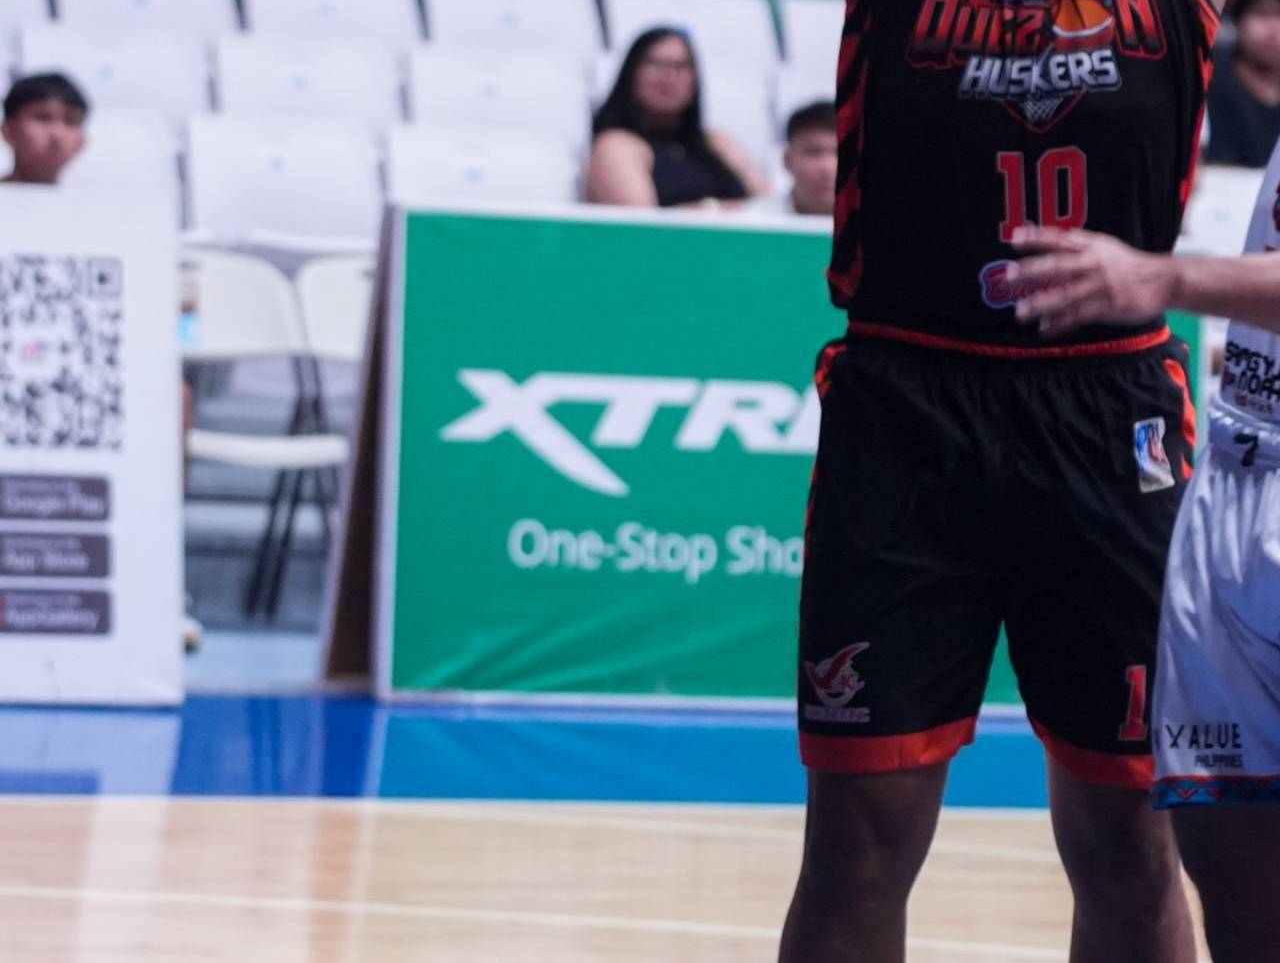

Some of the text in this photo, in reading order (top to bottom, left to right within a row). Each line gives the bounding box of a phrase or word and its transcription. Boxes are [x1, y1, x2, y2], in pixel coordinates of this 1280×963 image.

[960, 47, 1122, 98] HUSKERS
[996, 146, 1087, 243] 10
[439, 368, 823, 497] XTR
[1233, 432, 1258, 467] 7
[508, 518, 720, 585] One-Stop
